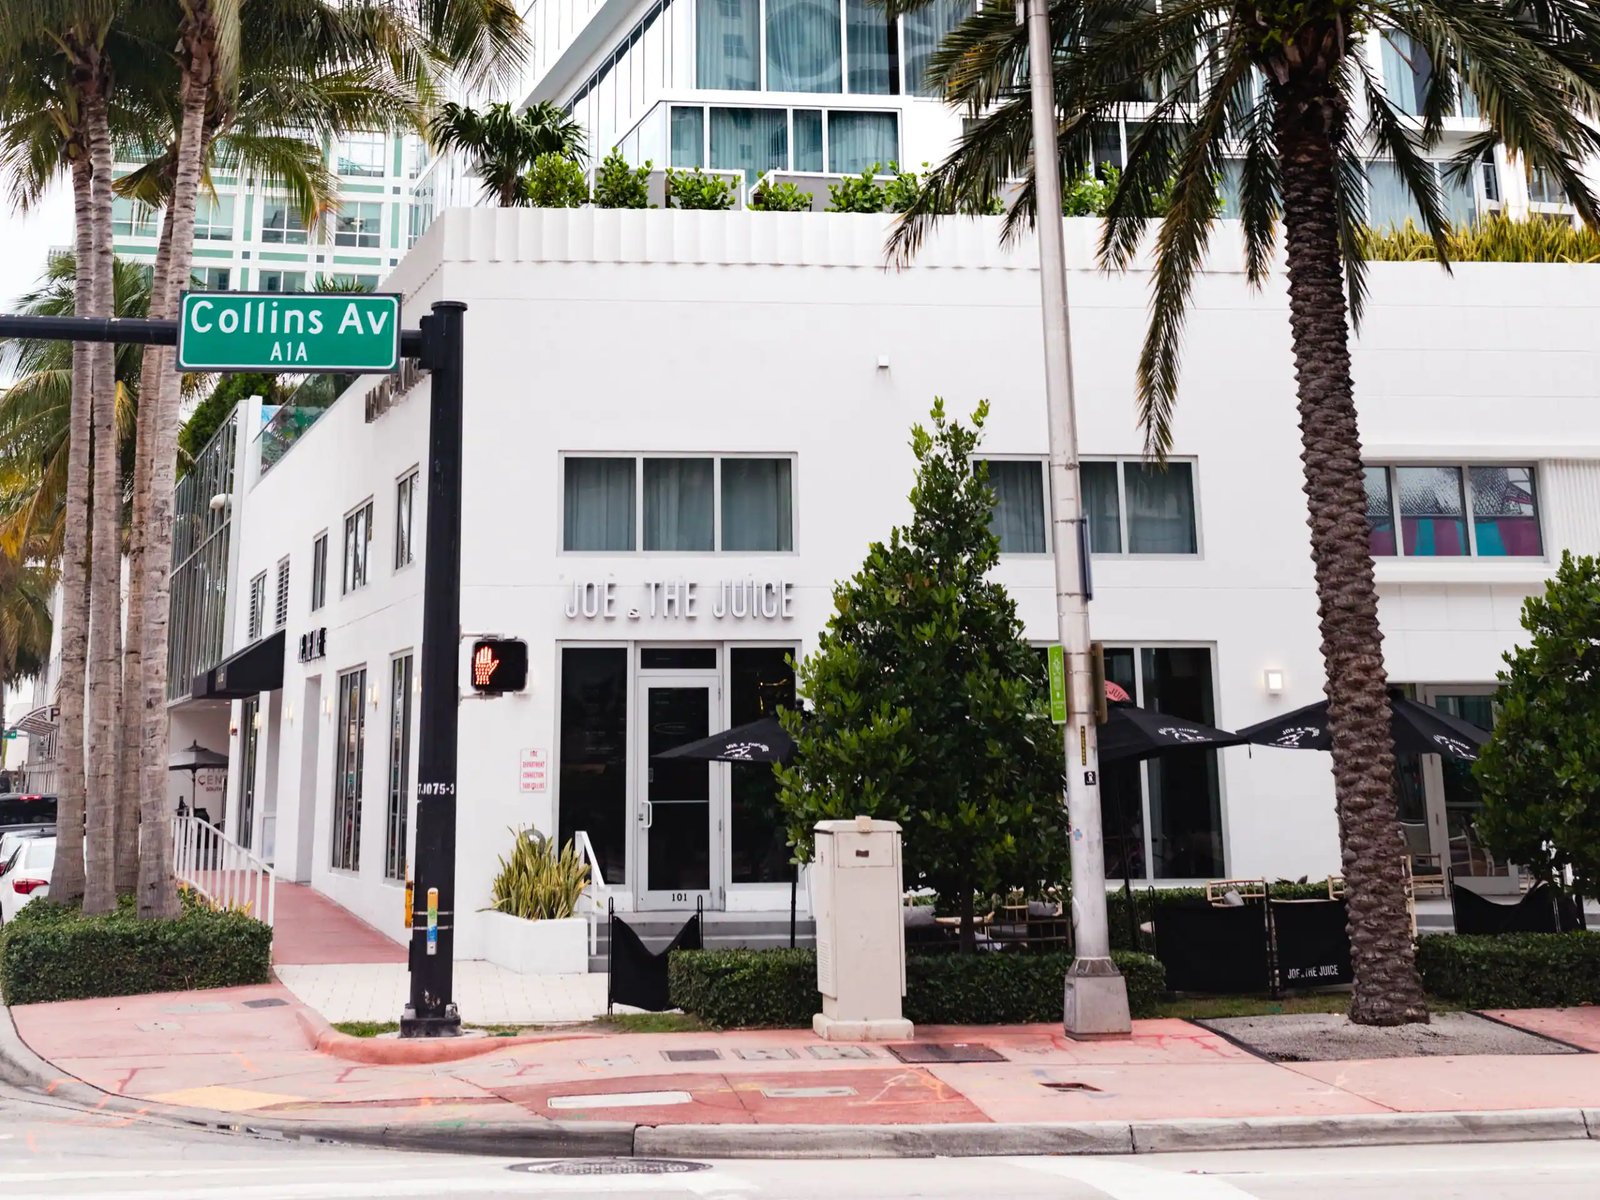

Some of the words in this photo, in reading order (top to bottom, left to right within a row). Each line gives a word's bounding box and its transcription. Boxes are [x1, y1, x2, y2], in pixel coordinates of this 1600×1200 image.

[191, 300, 324, 334] Collins
[337, 302, 389, 335] Av
[270, 341, 308, 361] A1A
[565, 580, 616, 618] JOE
[645, 580, 698, 618] THE
[712, 580, 794, 618] JUICE
[672, 893, 687, 901] 101
[1319, 964, 1339, 976] JUICE
